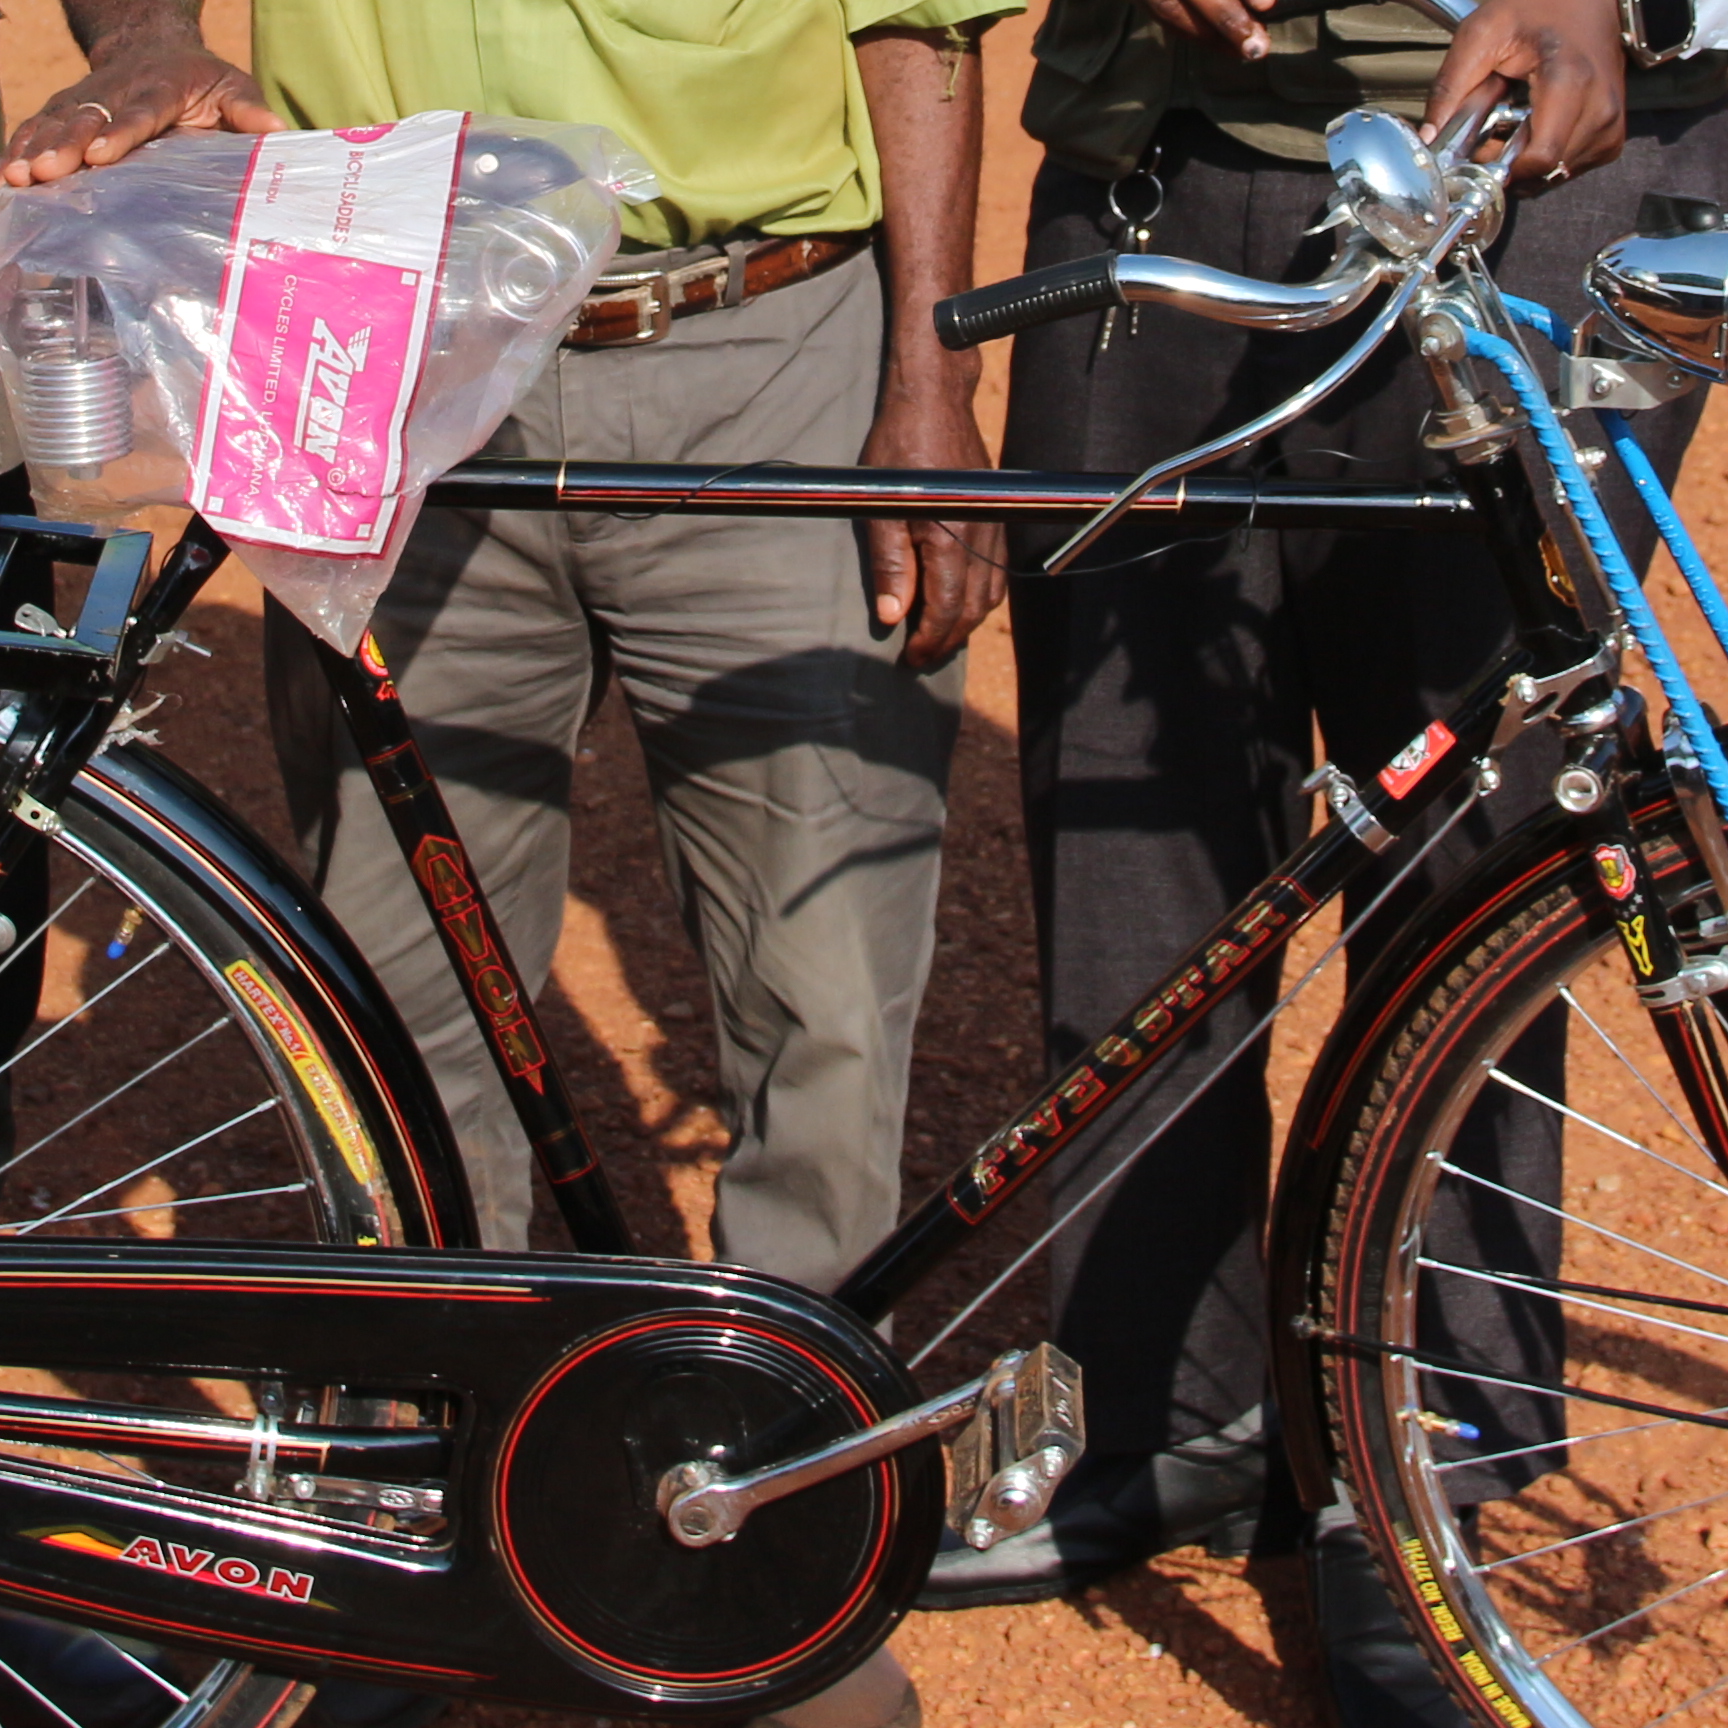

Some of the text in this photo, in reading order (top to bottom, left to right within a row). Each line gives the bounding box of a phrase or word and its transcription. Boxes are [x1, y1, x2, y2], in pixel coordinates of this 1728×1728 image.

[275, 274, 298, 335] CYCLES
[261, 337, 287, 406] LIMITED,
[300, 317, 358, 464] AVON
[427, 852, 547, 1078] AVON
[973, 900, 1287, 1195] FIVE STAR
[118, 1535, 314, 1604] AVON
[1419, 1581, 1444, 1604] NO
[1458, 1649, 1532, 1728] MADE IN INDIA
